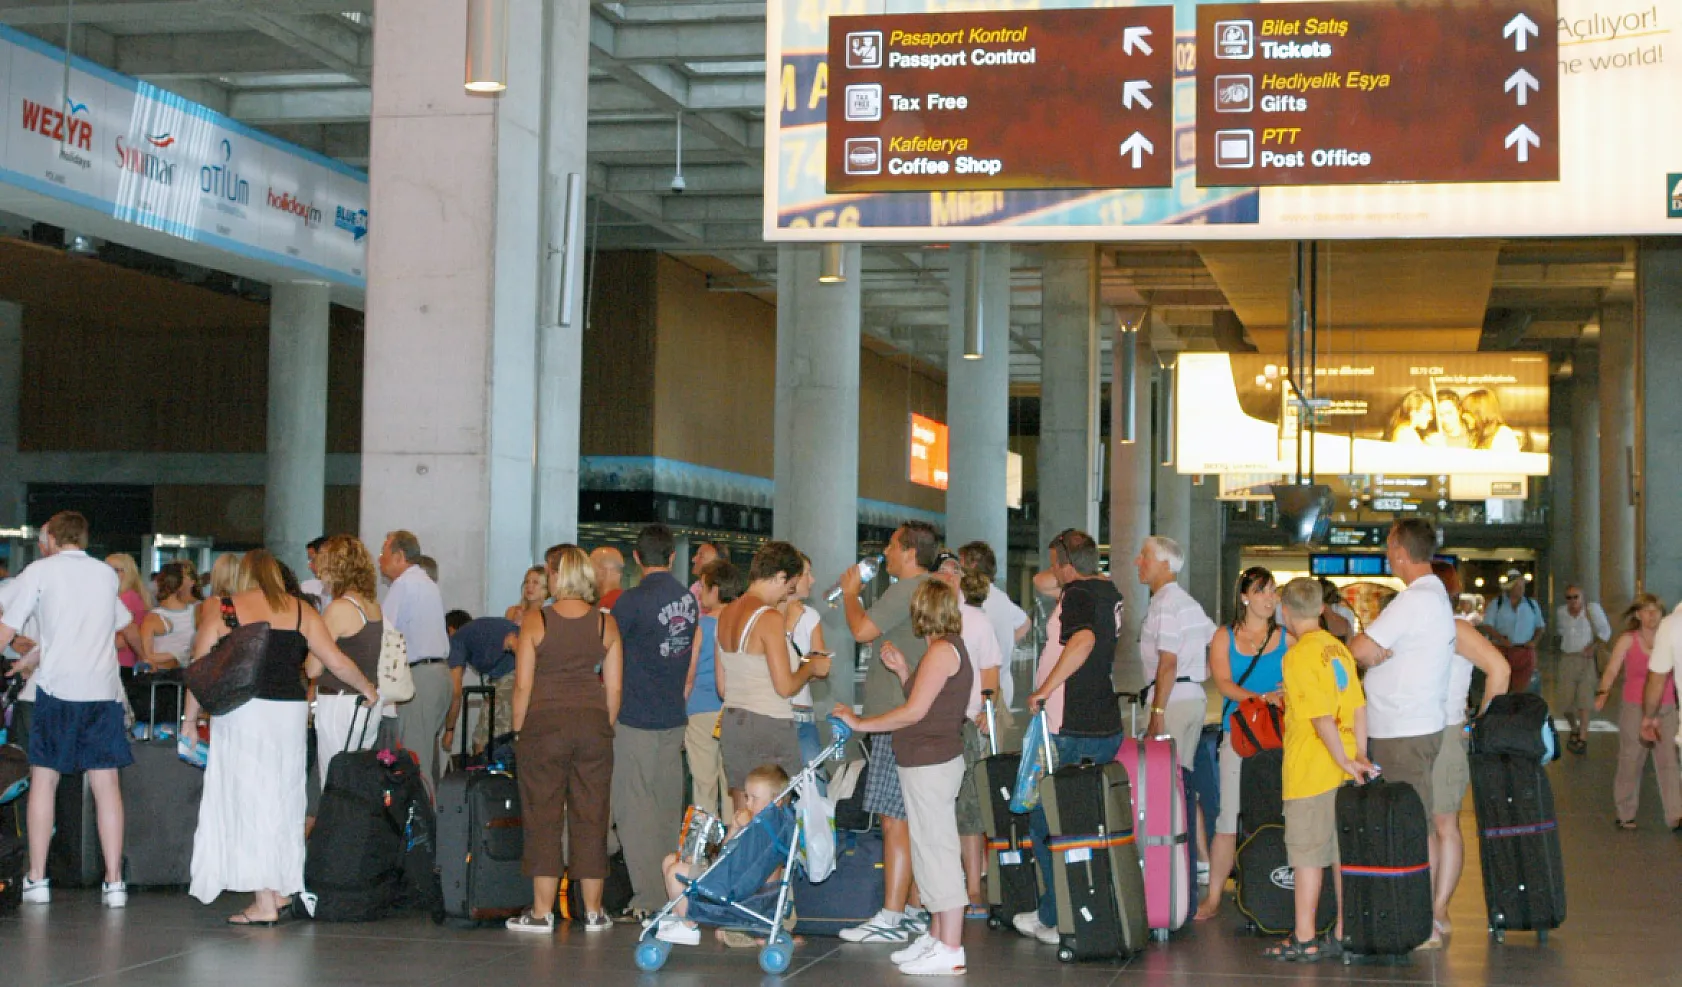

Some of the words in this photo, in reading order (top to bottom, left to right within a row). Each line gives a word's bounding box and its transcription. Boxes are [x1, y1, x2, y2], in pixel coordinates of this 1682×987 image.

[1261, 19, 1301, 36] Bilet
[1304, 16, 1349, 37] Satış
[889, 29, 964, 48] Pasaport
[968, 26, 1028, 44] Kontrol
[888, 50, 967, 70] Passport
[970, 47, 1036, 66] Control
[1260, 41, 1332, 59] Tickets
[1589, 44, 1663, 71] world!
[1261, 72, 1342, 92] Hediyelik
[1346, 71, 1391, 91] Eşya
[888, 94, 920, 111] Tax
[927, 93, 968, 110] Free
[1260, 95, 1307, 112] Gifts
[22, 97, 93, 152] WEZYR
[888, 135, 968, 155] Kafeterya
[1261, 127, 1302, 145] PTT
[888, 157, 949, 175] Coffee
[955, 156, 1002, 176] Shop
[1261, 150, 1304, 168] Post
[1311, 148, 1372, 167] Office
